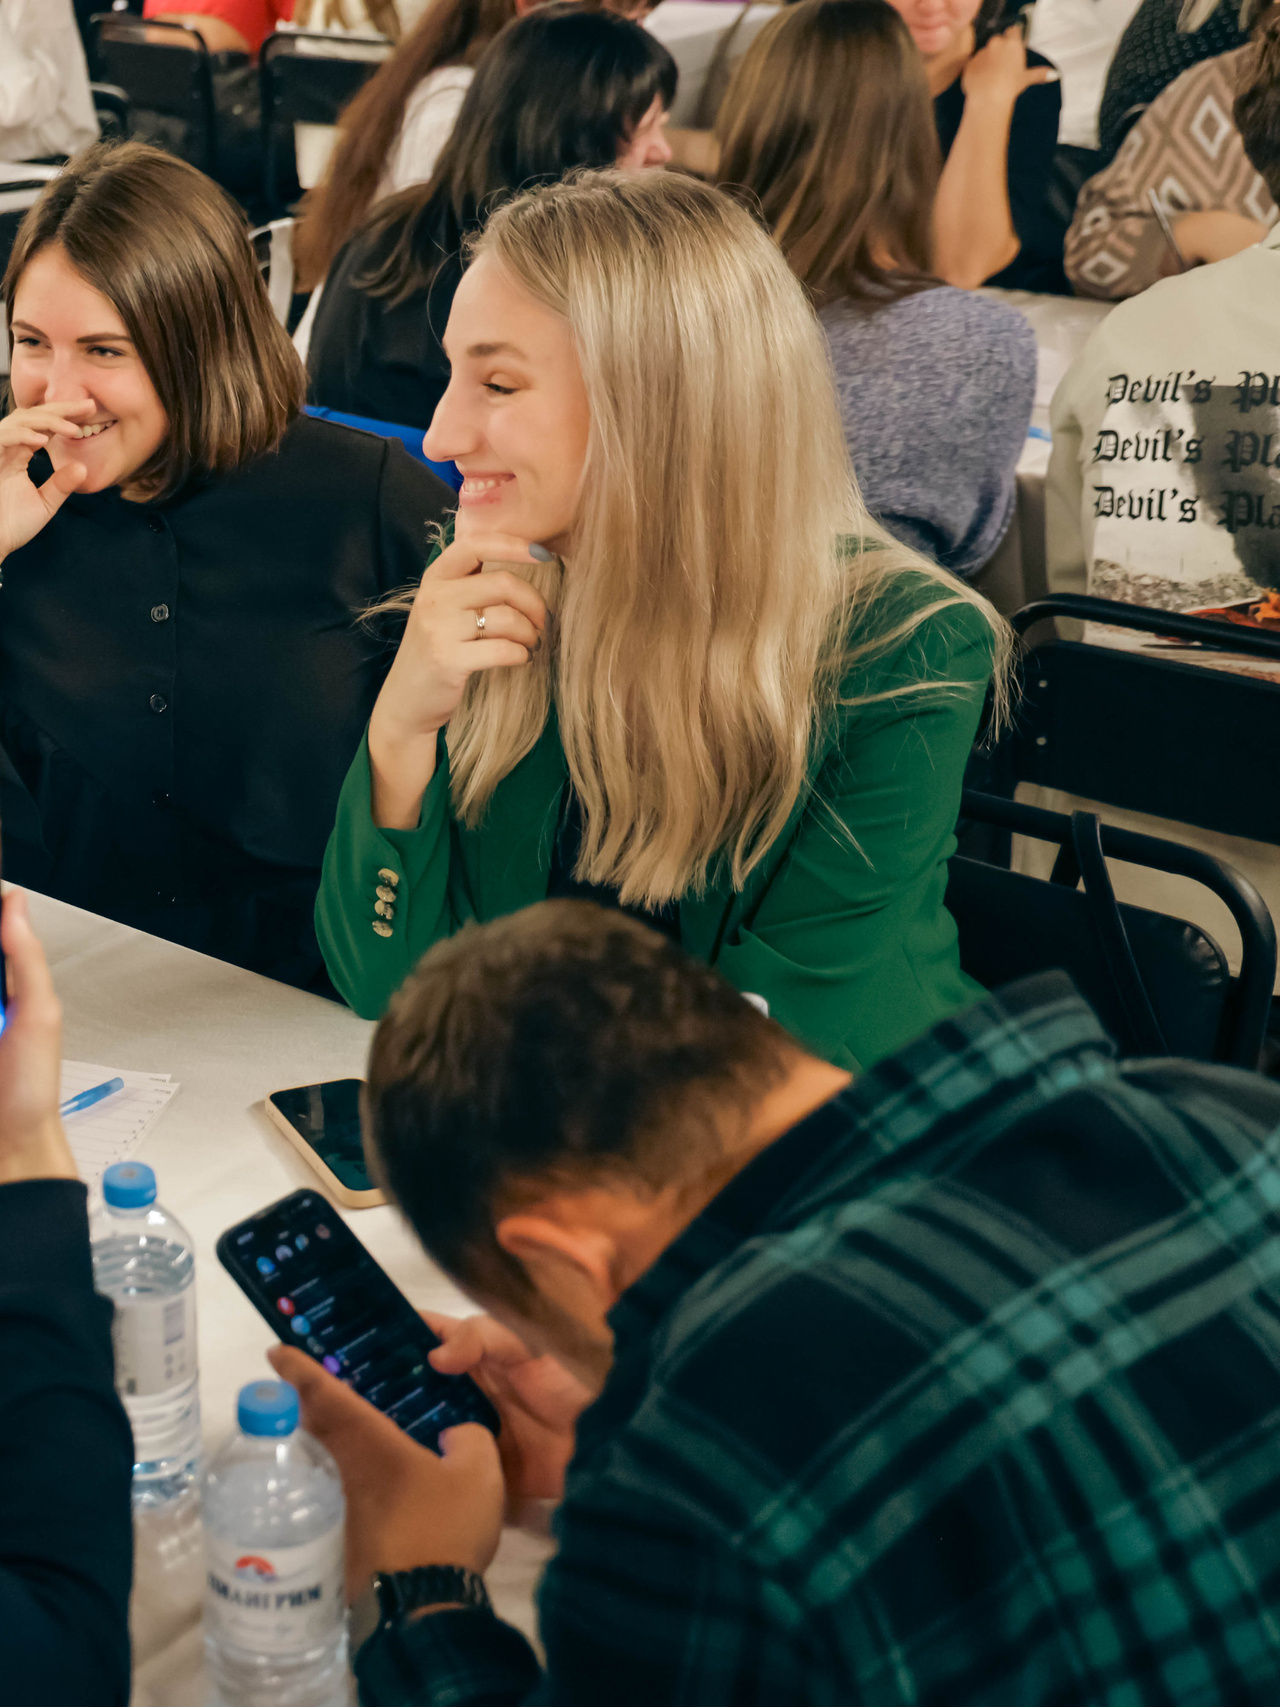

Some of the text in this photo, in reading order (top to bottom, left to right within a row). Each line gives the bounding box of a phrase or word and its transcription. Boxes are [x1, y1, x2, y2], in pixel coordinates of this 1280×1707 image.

[1105, 370, 1216, 405] Devil's
[1093, 429, 1206, 464] Devil's
[1093, 486, 1201, 524] Devil's
